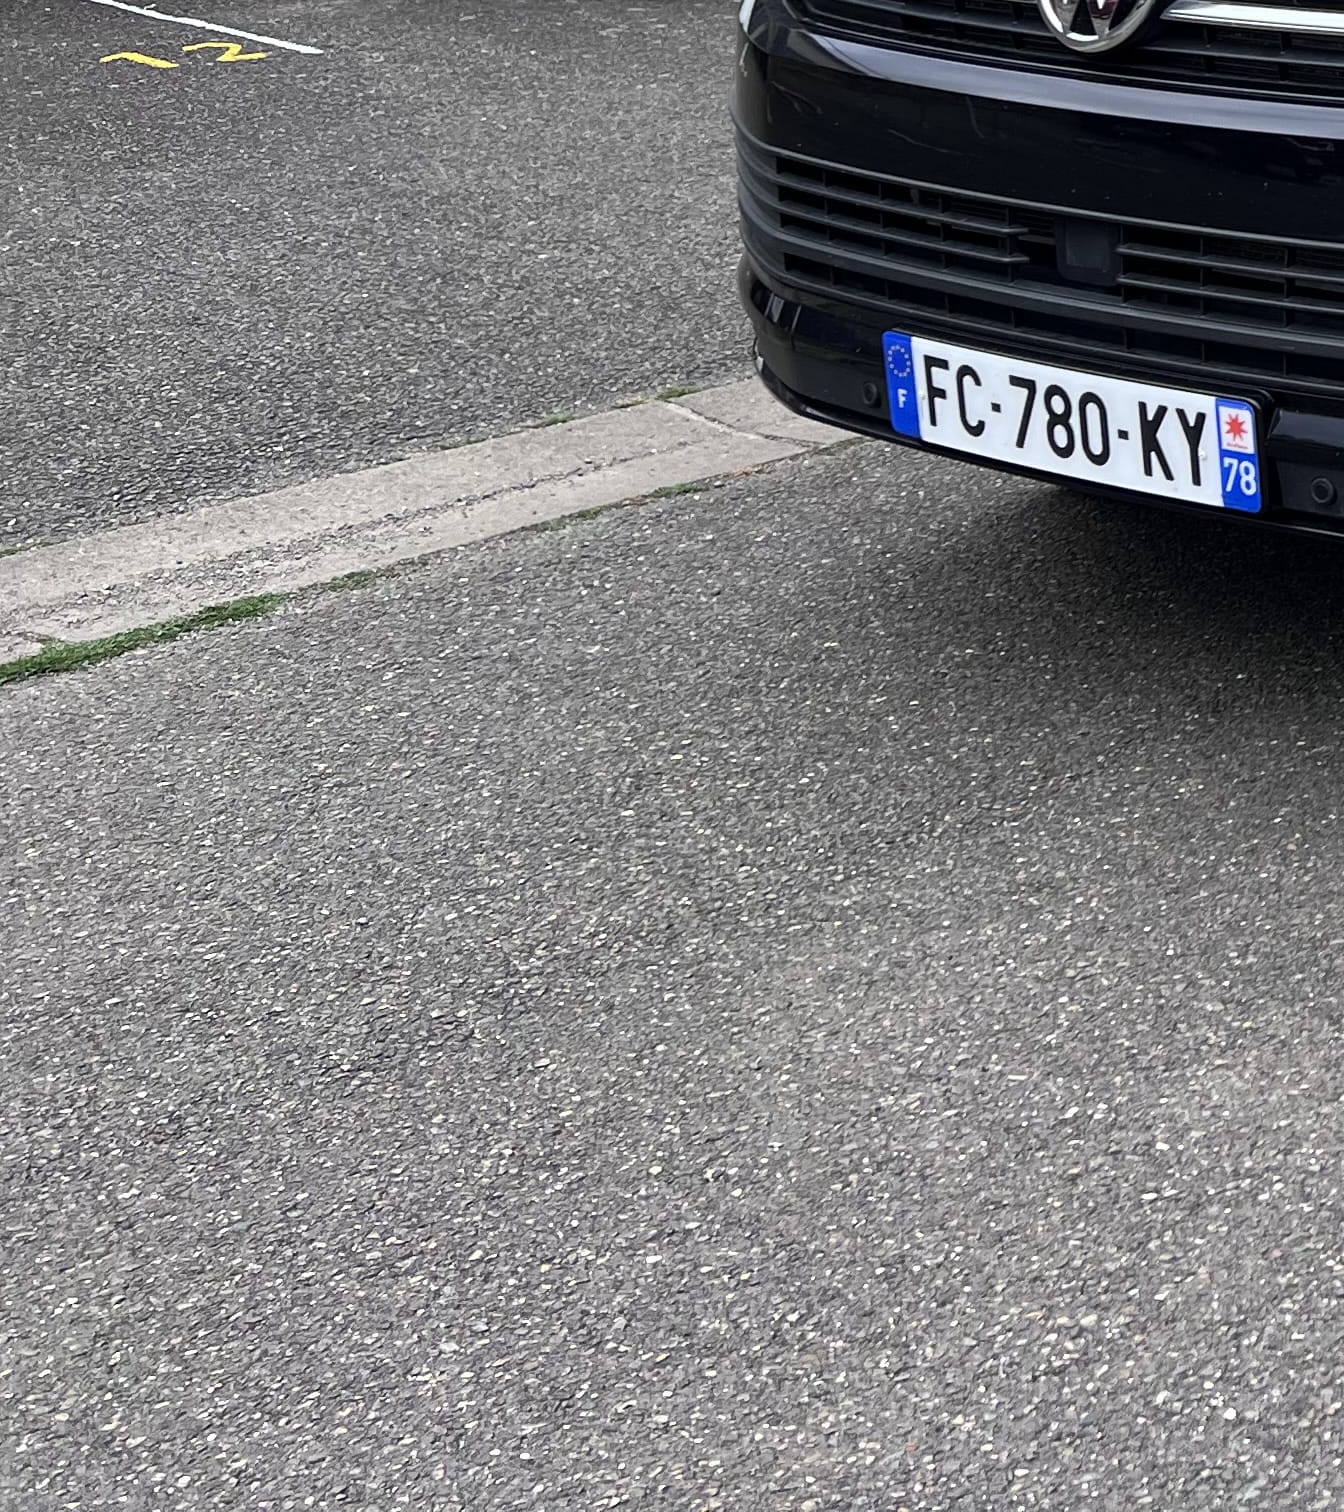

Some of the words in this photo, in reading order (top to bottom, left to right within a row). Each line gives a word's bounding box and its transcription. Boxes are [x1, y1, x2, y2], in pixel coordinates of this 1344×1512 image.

[898, 388, 907, 409] F
[923, 354, 1207, 487] FC-780-KY
[1223, 456, 1257, 496] 78
